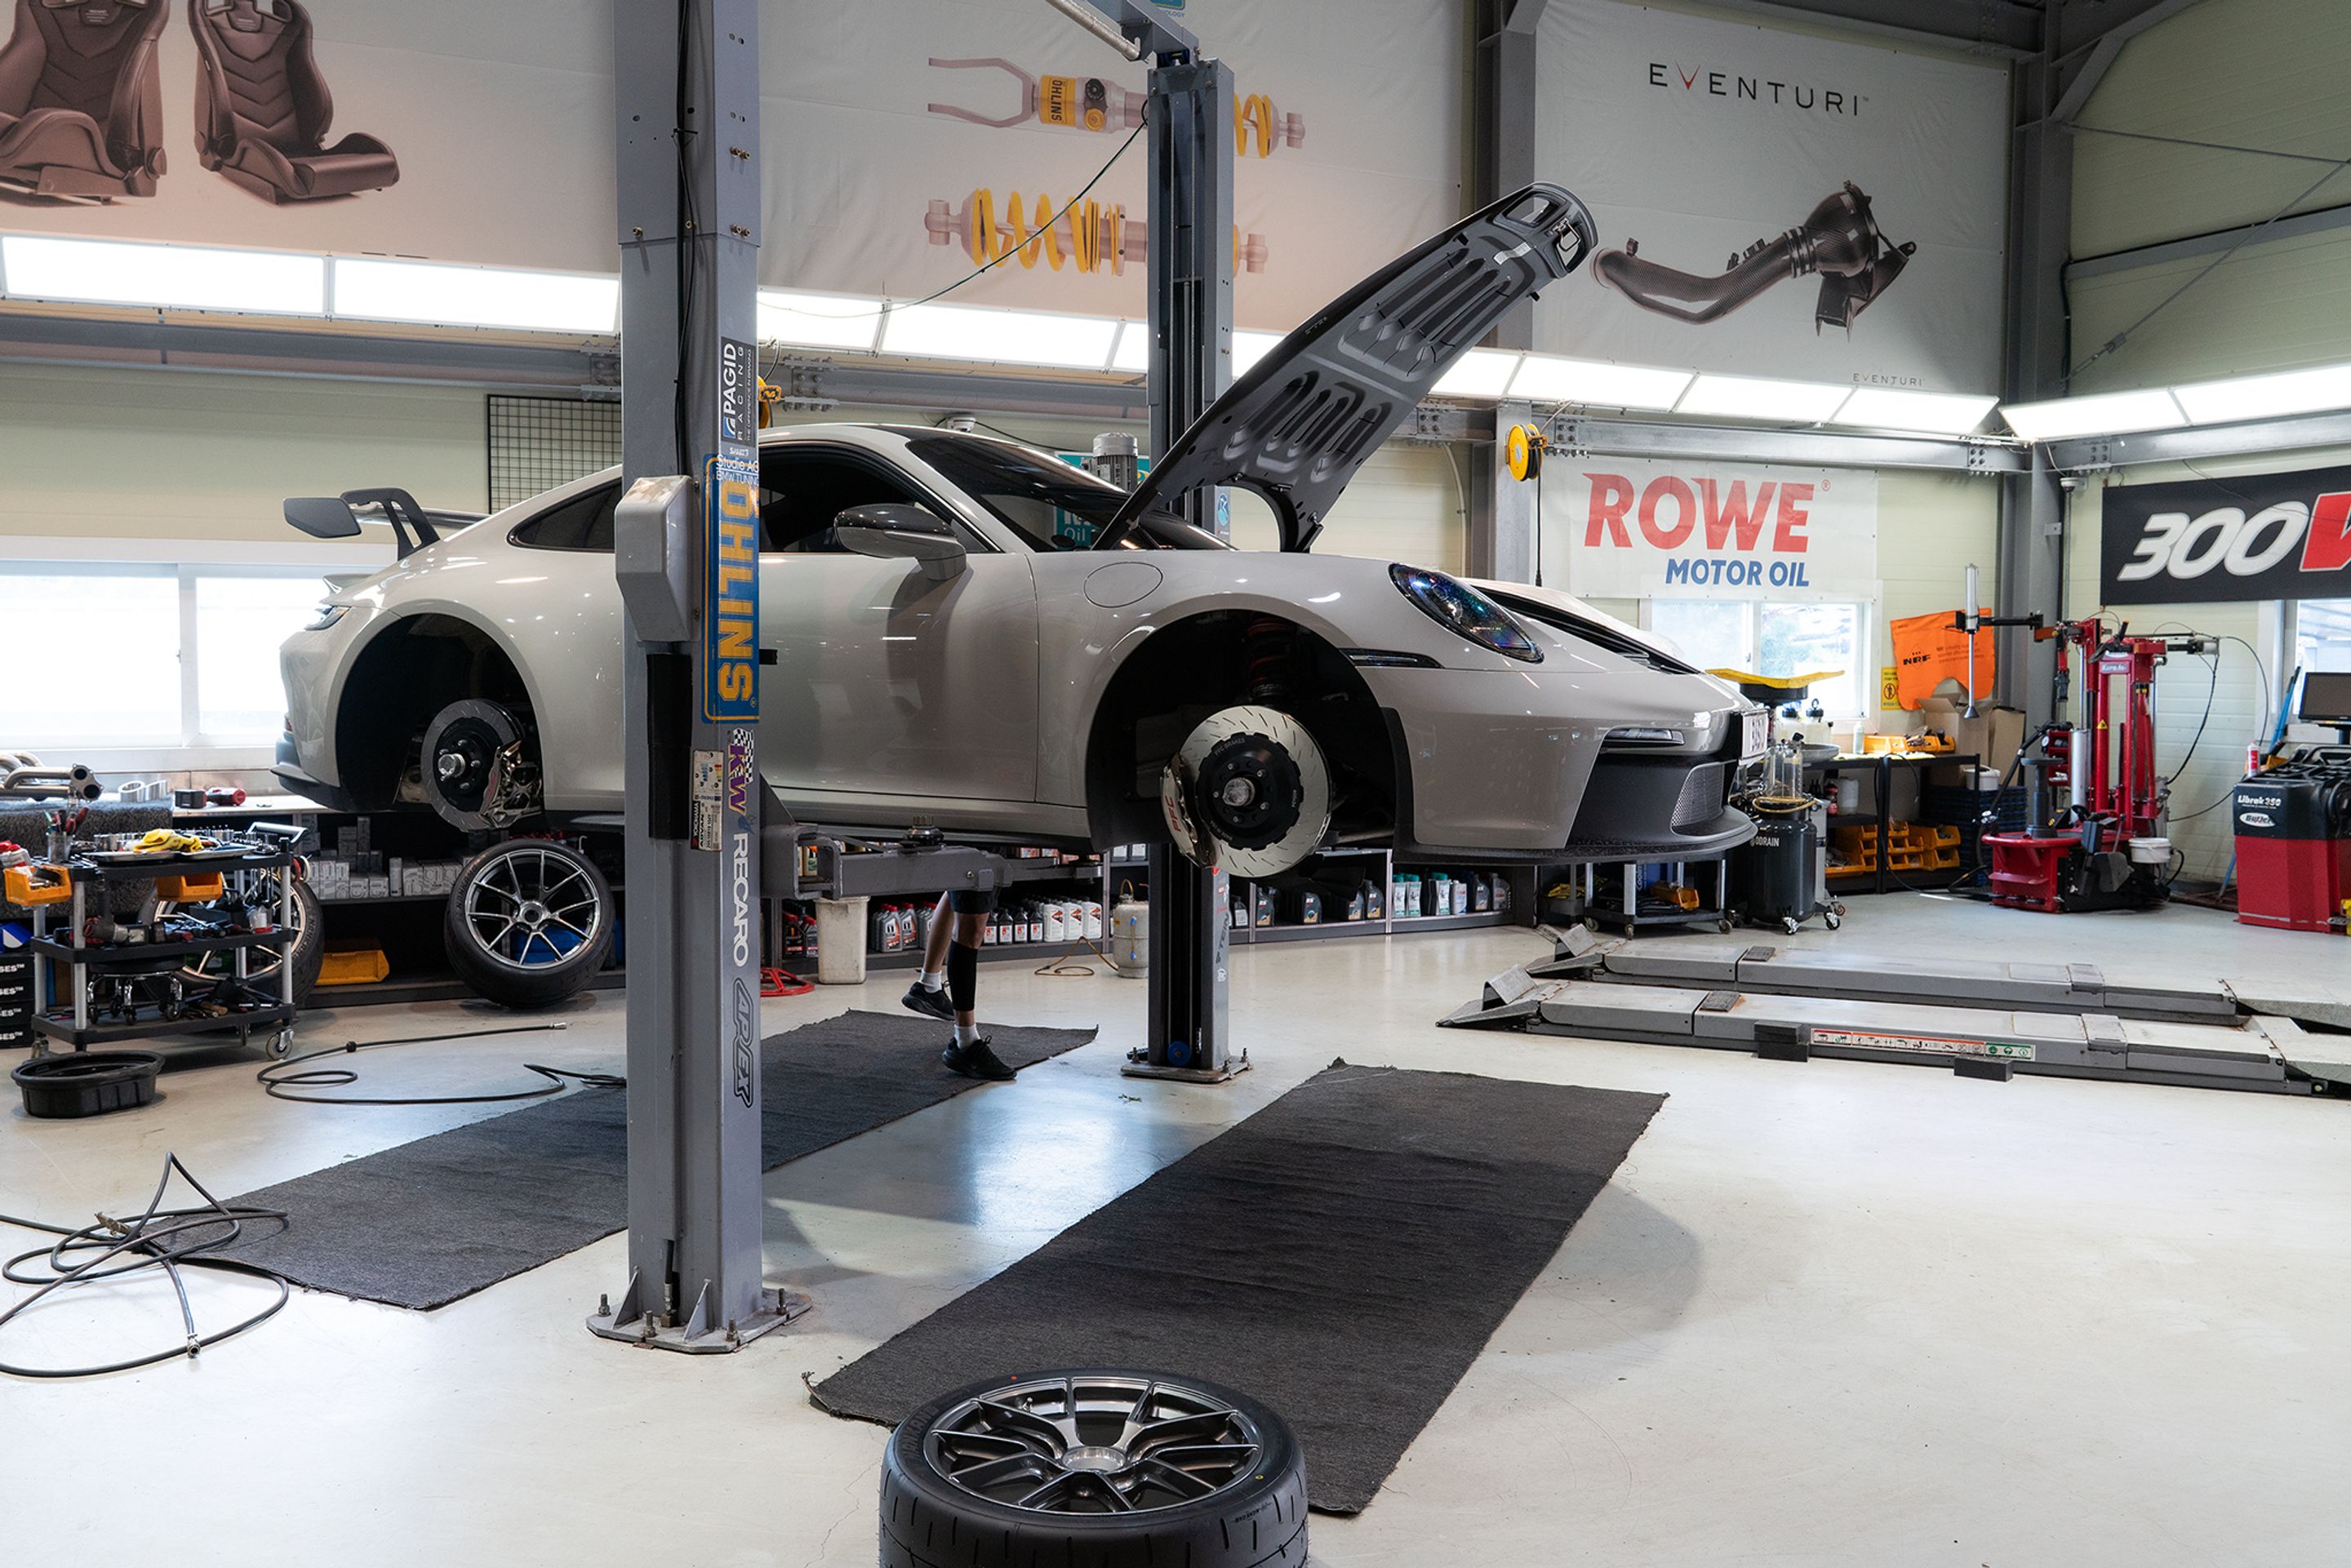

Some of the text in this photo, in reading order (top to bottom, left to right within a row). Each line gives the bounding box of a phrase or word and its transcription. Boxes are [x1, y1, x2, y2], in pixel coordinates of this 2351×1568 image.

[1649, 60, 1858, 116] EVENTURI
[723, 343, 736, 415] PAGID
[1853, 373, 1922, 386] EVENTURI
[716, 454, 745, 471] Studie
[717, 470, 736, 483] BMW
[1582, 473, 1815, 553] ROWE
[1665, 558, 1809, 587] MOTOR OIL
[728, 744, 746, 815] KW
[1165, 795, 1181, 833] PFC
[733, 833, 749, 966] RECARO
